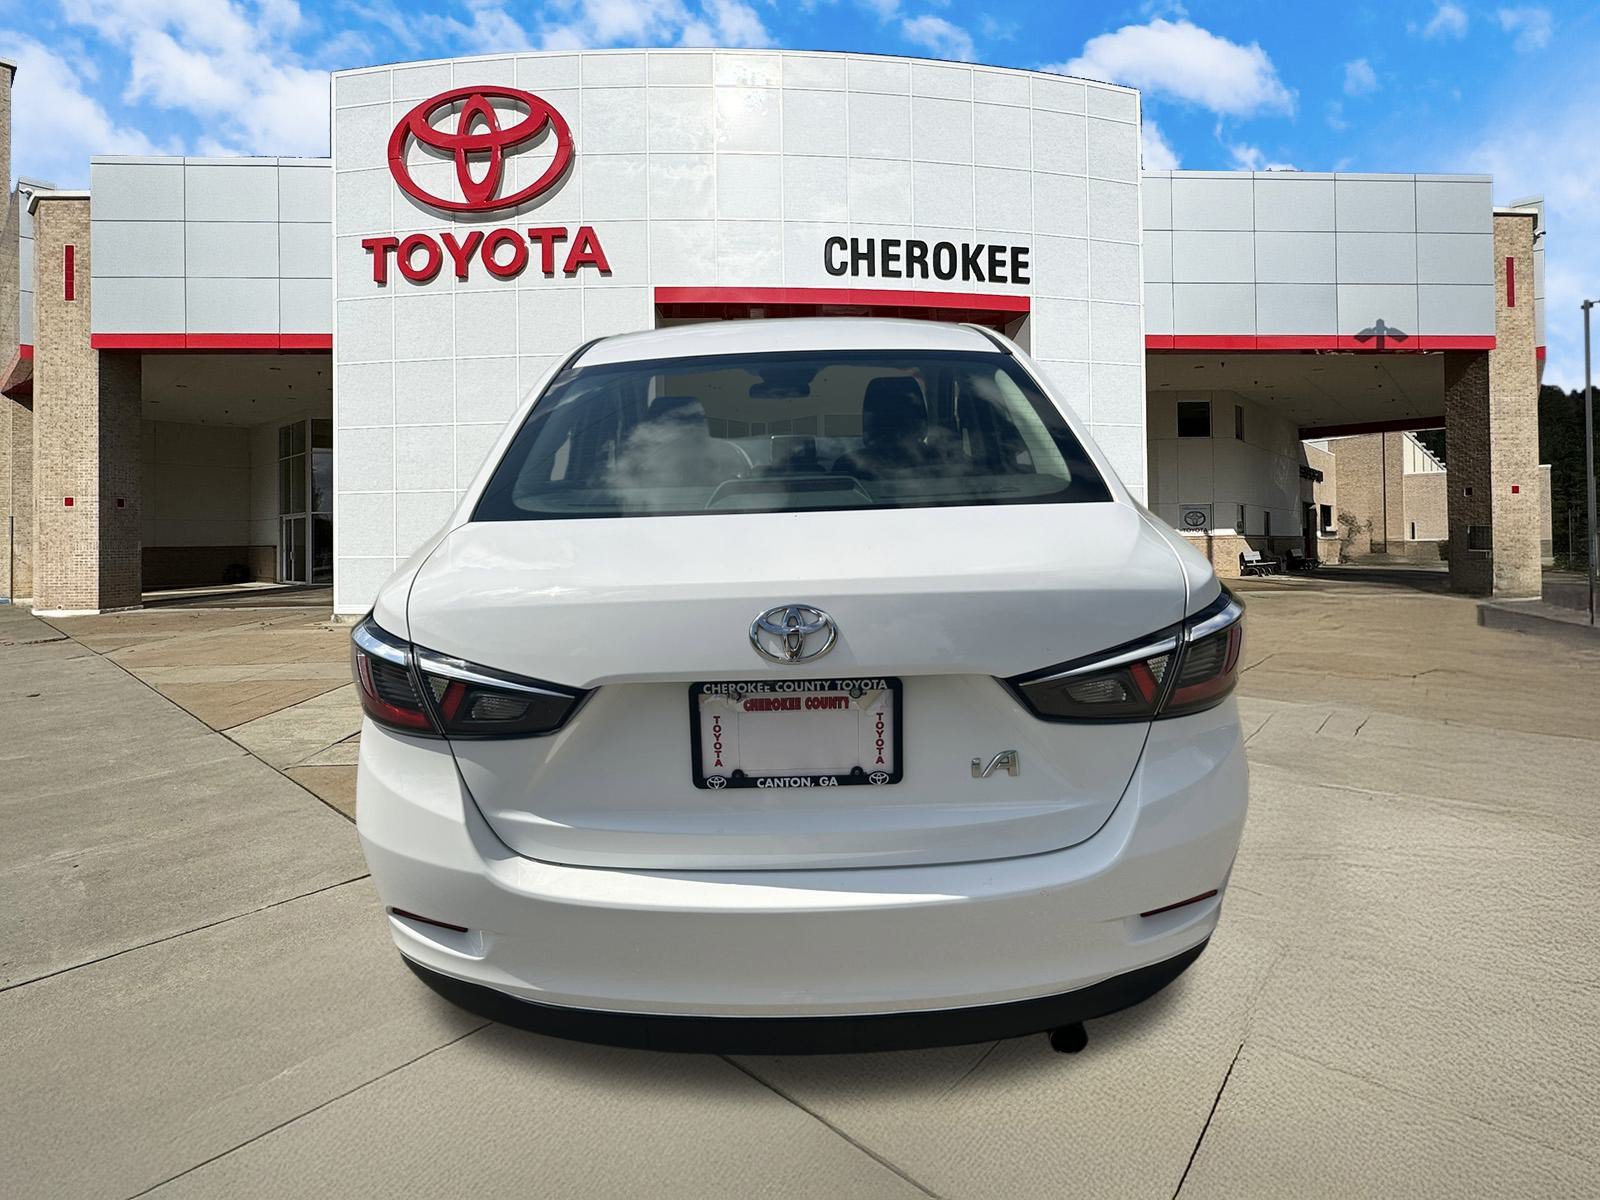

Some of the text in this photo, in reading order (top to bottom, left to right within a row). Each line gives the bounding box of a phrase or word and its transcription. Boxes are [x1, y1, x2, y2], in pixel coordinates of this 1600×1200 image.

[361, 226, 612, 286] TOYOTA
[824, 236, 1030, 285] CHEROKEE
[703, 679, 888, 694] CHEROKEE COUNTY TOYOTA
[743, 696, 849, 711] CHEROKEE COUNTY
[713, 715, 723, 767] TOYOTA
[875, 712, 885, 764] TOYOTA
[756, 775, 838, 788] CANTON, GA
